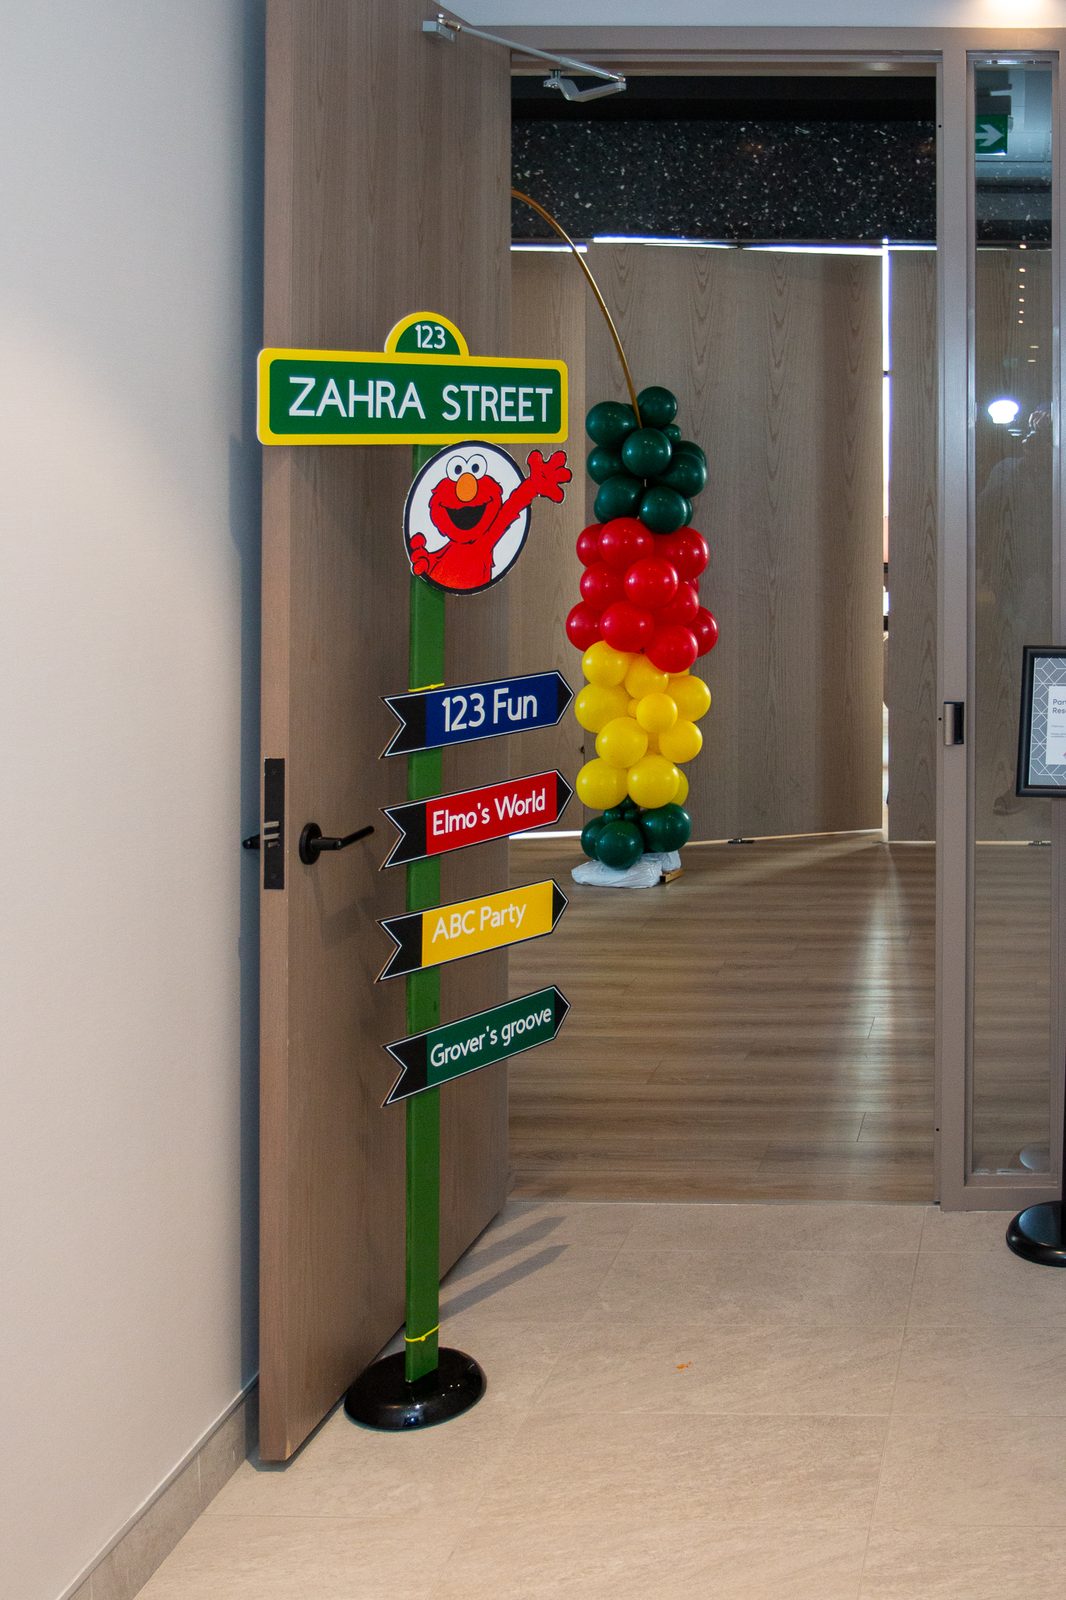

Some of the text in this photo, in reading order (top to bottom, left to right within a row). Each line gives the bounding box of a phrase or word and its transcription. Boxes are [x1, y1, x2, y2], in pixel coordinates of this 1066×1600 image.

[416, 325, 446, 349] 123
[289, 377, 553, 422] ZAHRA STREET
[441, 688, 538, 732] 123 Fun
[432, 788, 546, 836] Elmo's World
[431, 904, 527, 943] ABC Party
[430, 1008, 552, 1067] Grover's groove
